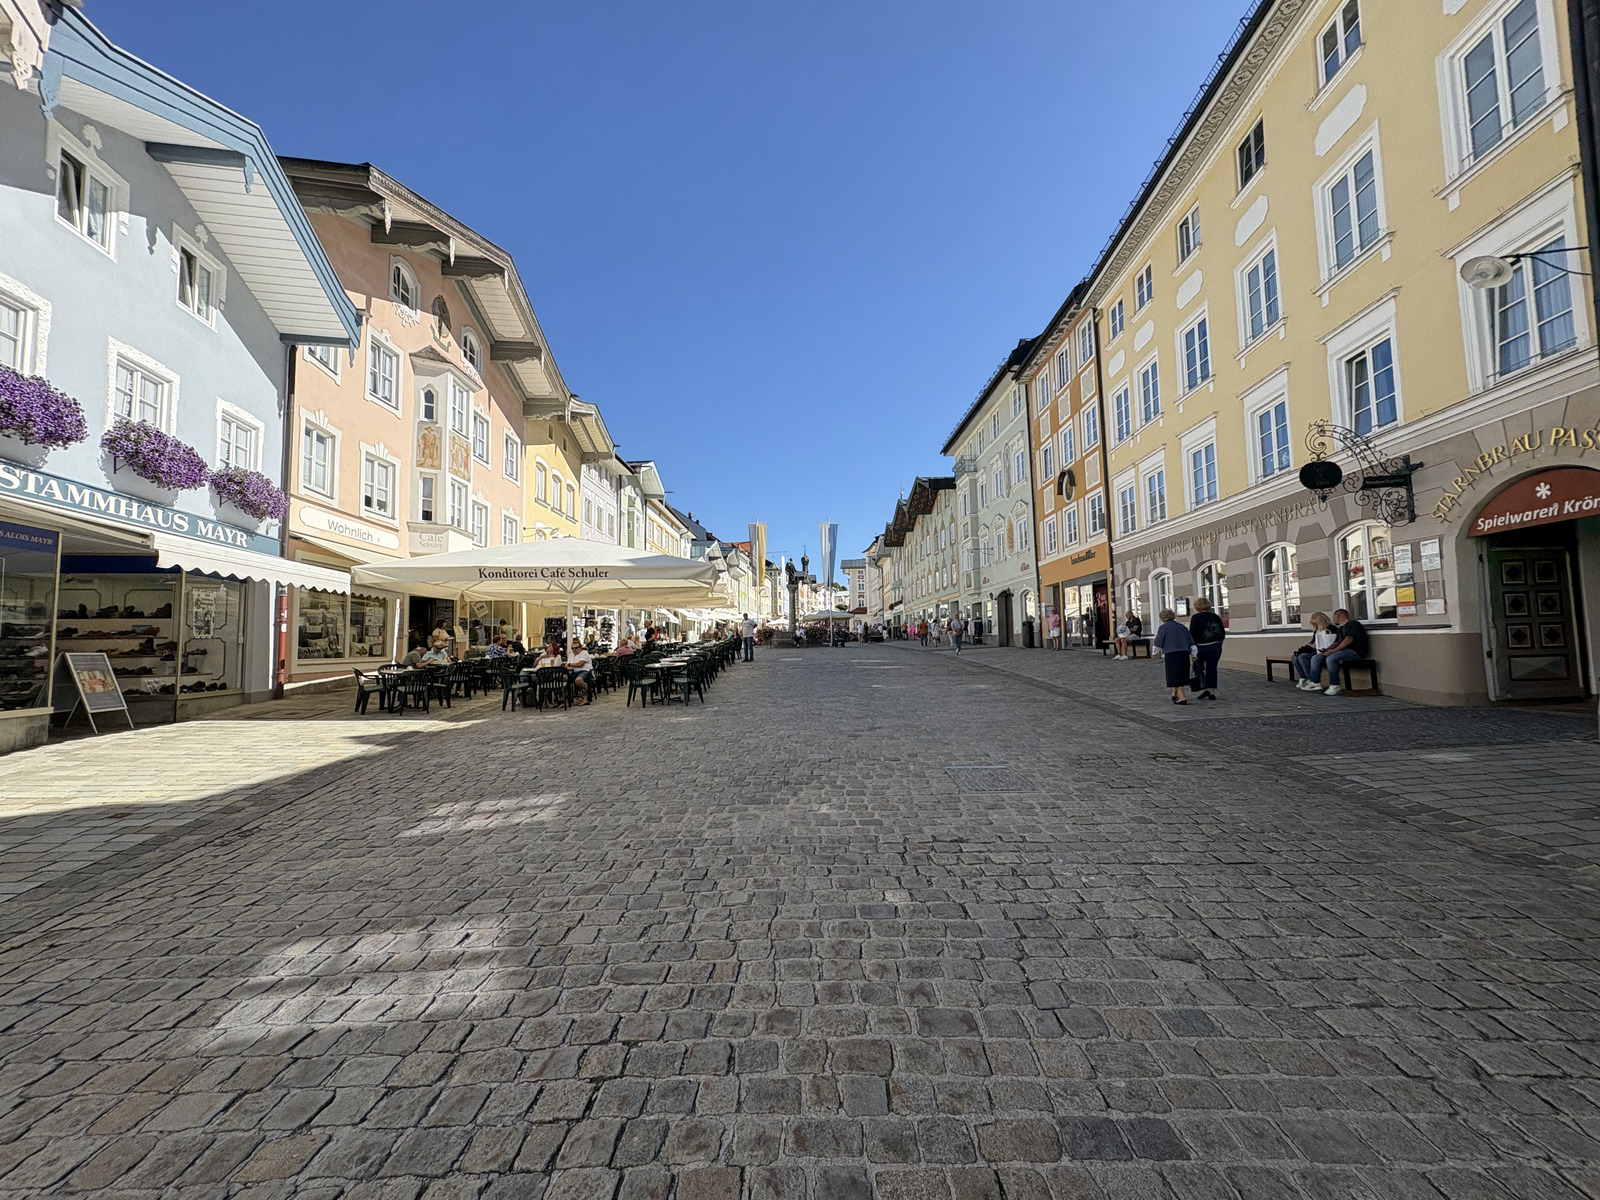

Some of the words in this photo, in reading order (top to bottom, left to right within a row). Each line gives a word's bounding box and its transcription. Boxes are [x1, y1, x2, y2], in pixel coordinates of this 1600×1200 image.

[1431, 429, 1543, 524] STARNBRÄU
[0, 464, 189, 532] STAMMHAUS
[197, 520, 248, 548] MAYR
[1477, 505, 1558, 531] Spielwaren
[4, 531, 29, 541] ALOIS
[30, 536, 54, 545] MAYR
[327, 519, 373, 542] Wohnlich
[478, 568, 538, 579] Konditorei
[540, 567, 566, 579] Café
[568, 567, 610, 579] Schuler
